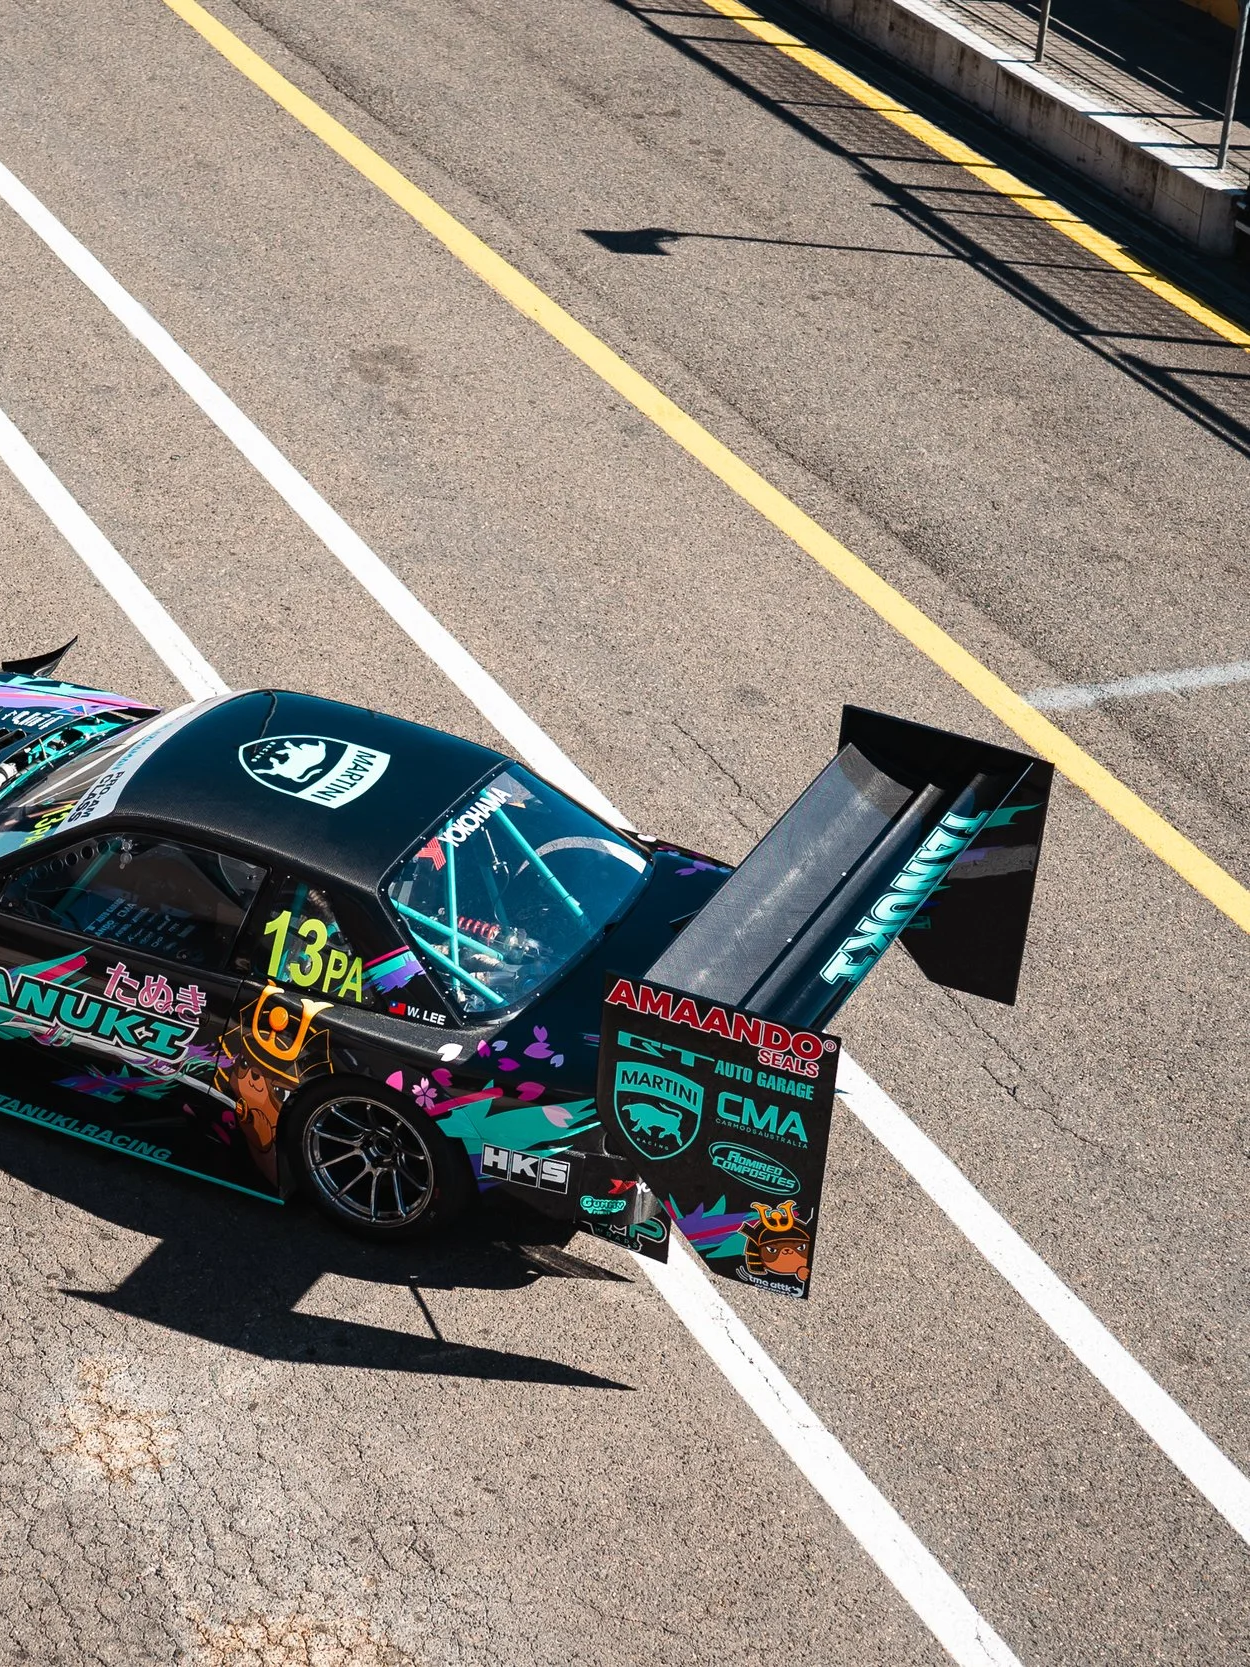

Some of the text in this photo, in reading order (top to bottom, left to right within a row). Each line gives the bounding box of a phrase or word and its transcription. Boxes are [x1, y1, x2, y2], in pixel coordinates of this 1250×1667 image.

[68, 774, 115, 822] CLASS
[84, 771, 125, 818] PRO-AM
[310, 750, 377, 801] MARTINI
[438, 787, 512, 847] YOKOHAMA
[820, 811, 992, 985] TANUKI
[104, 962, 207, 1024] たぬき
[407, 1005, 447, 1026] W. LEE
[606, 978, 823, 1060] AMAANDO
[618, 1031, 814, 1101] GT AUTO GARAGE
[757, 1049, 819, 1078] SEALS
[621, 1070, 698, 1107] MARTINI
[715, 1118, 808, 1149] CARMODSAUSTRALIA
[716, 1091, 808, 1143] CMA
[483, 1146, 567, 1184] HKS
[636, 1138, 669, 1151] RACING
[712, 1155, 796, 1188] COMPOSITES
